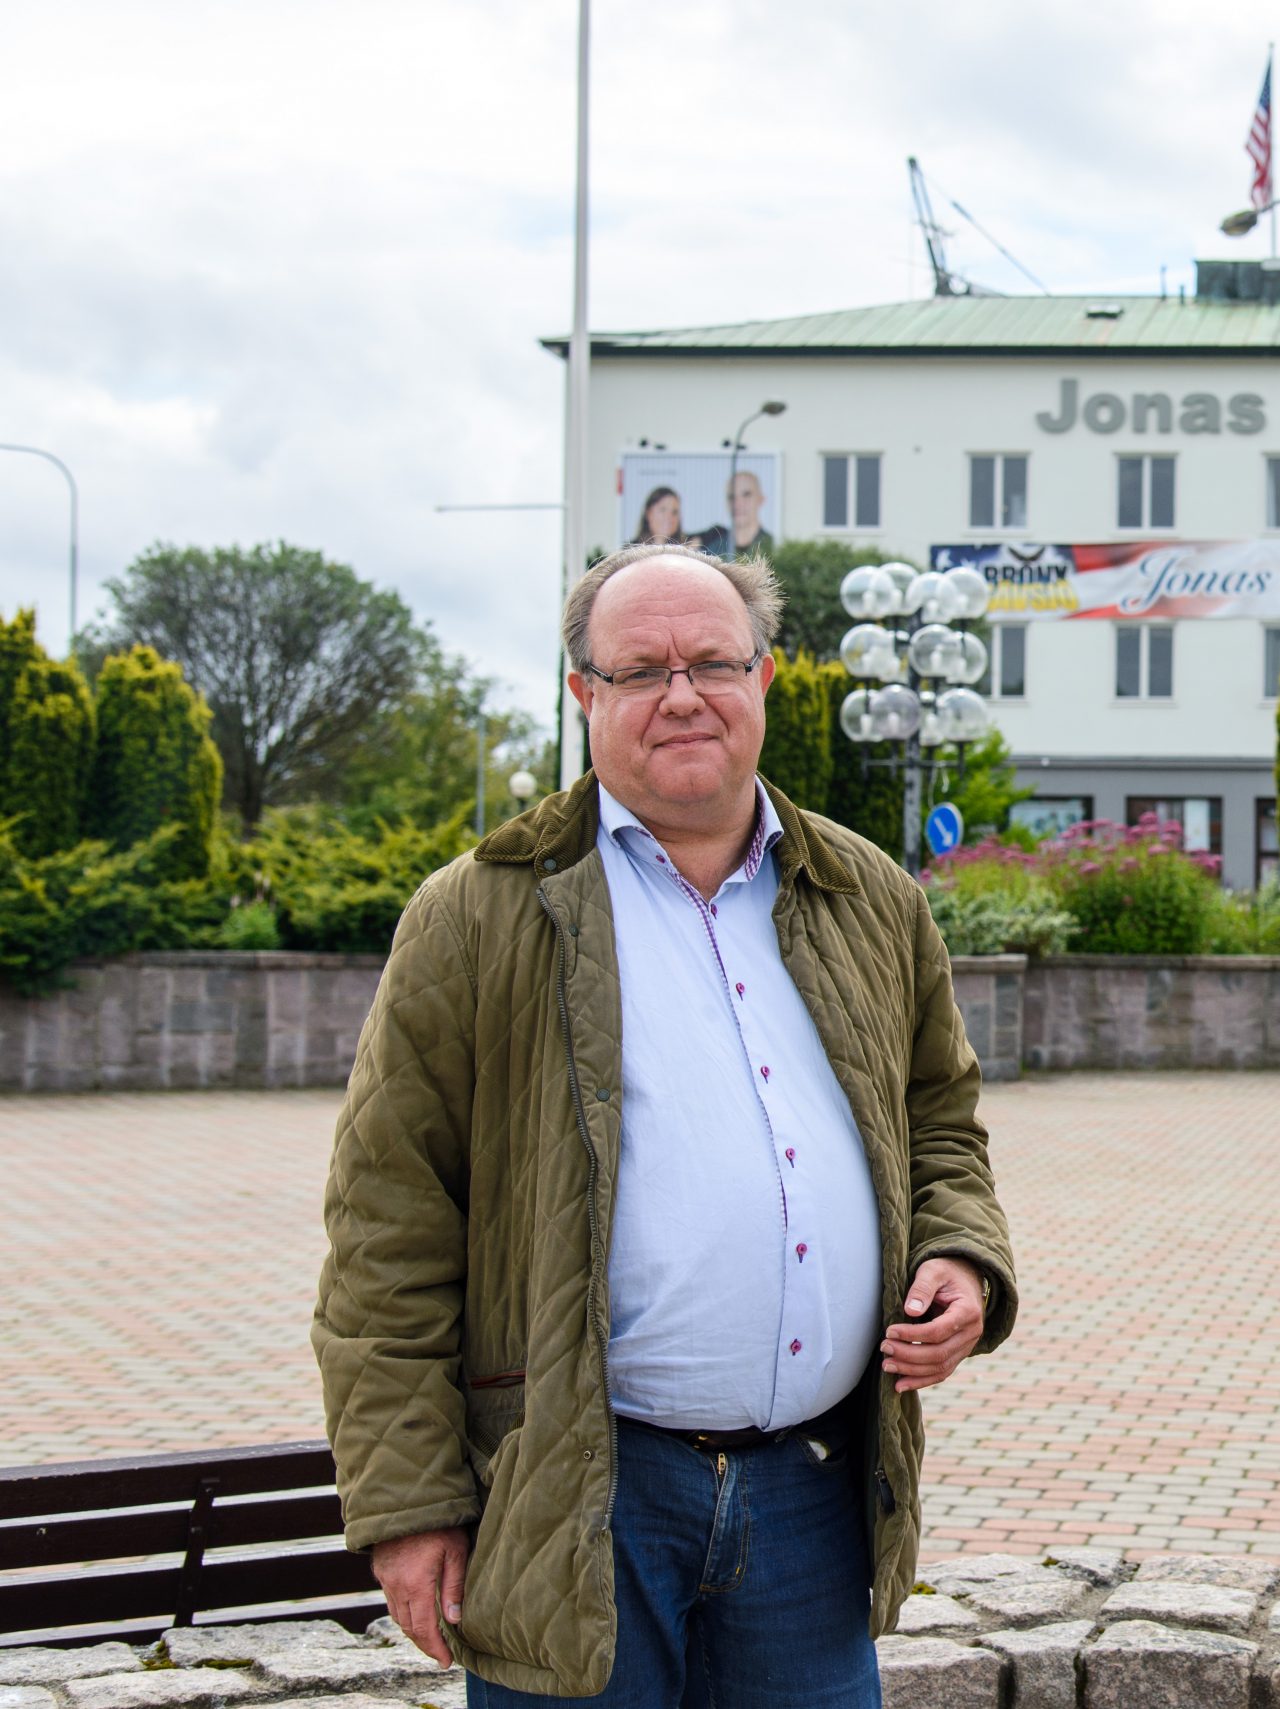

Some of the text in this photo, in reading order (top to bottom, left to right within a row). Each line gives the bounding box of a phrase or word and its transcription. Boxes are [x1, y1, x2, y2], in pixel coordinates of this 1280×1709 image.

[1036, 378, 1267, 435] Jonas
[984, 565, 1068, 586] BRONX
[1119, 550, 1273, 614] Jonas
